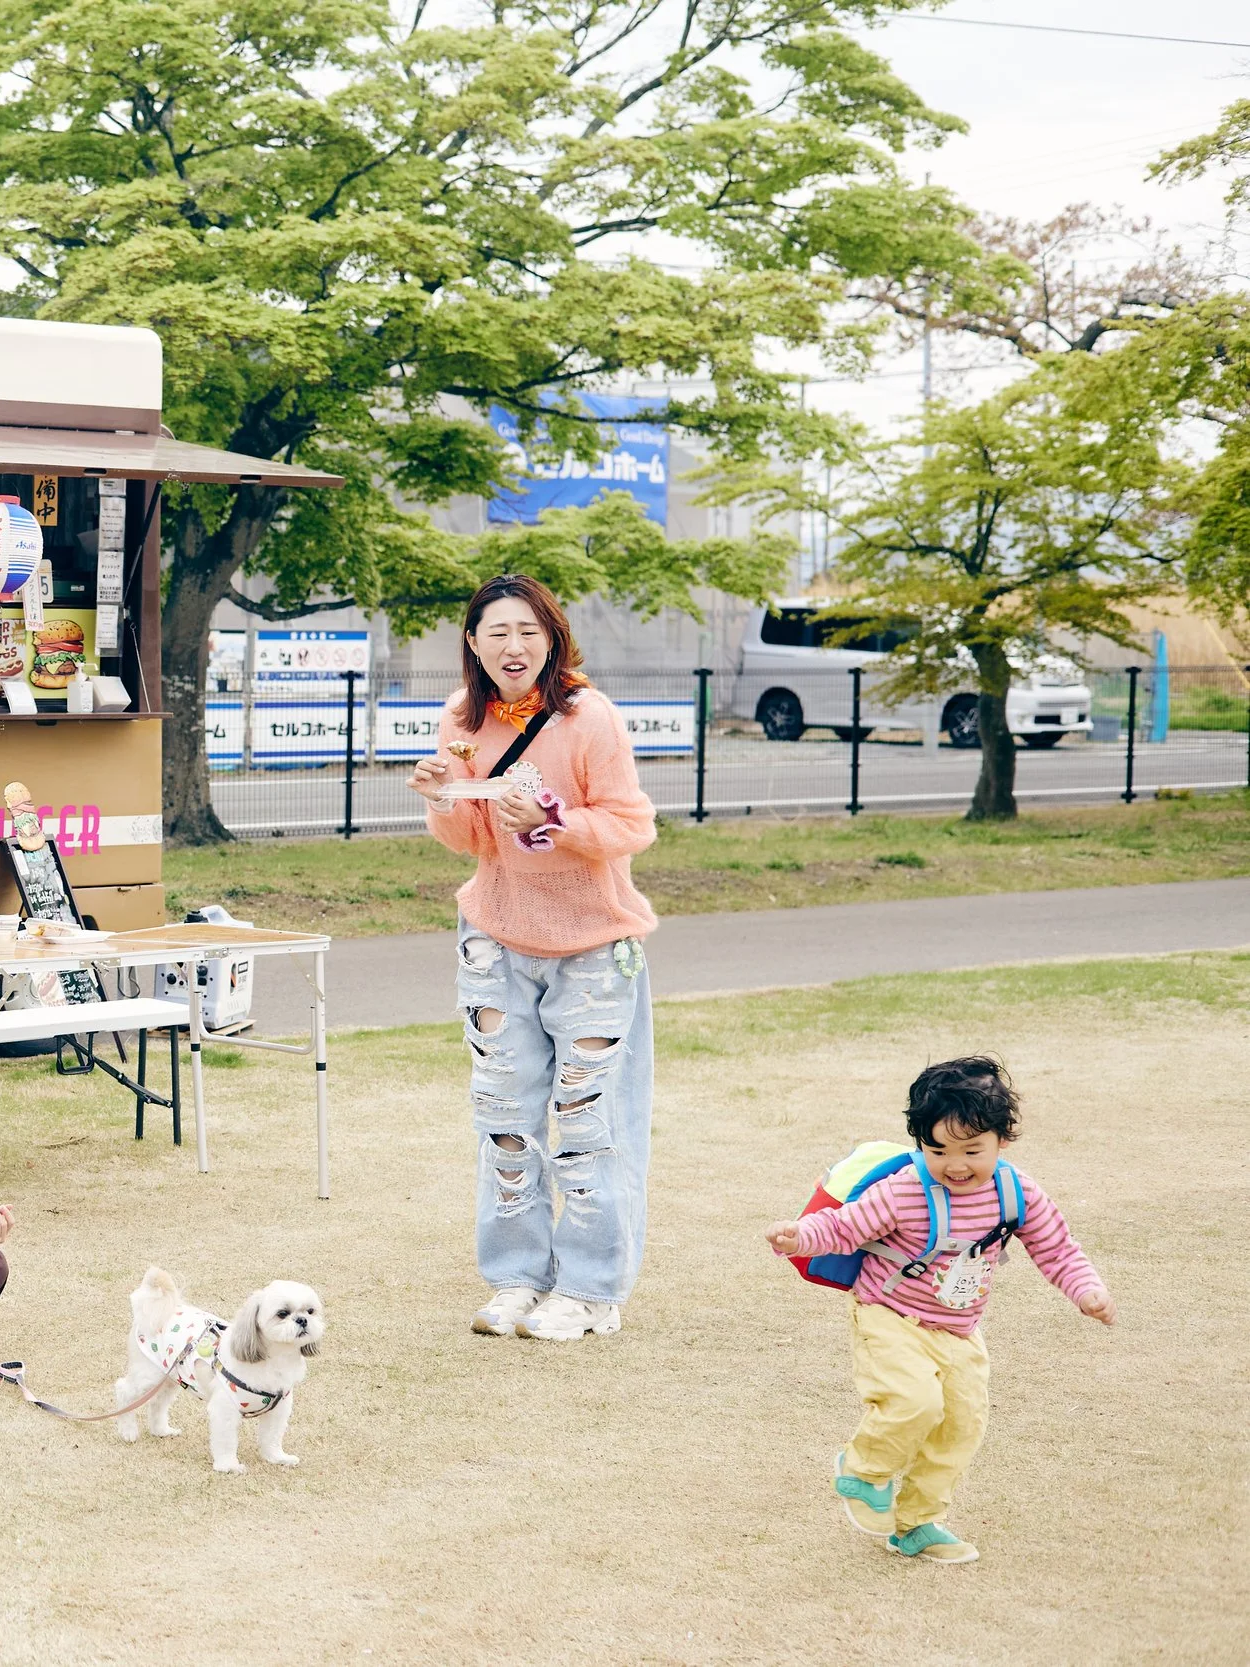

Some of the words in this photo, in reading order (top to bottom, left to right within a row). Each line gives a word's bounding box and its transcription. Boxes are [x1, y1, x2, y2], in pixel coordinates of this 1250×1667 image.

[36, 475, 55, 523] 備中
[271, 722, 357, 737] セルコホーム
